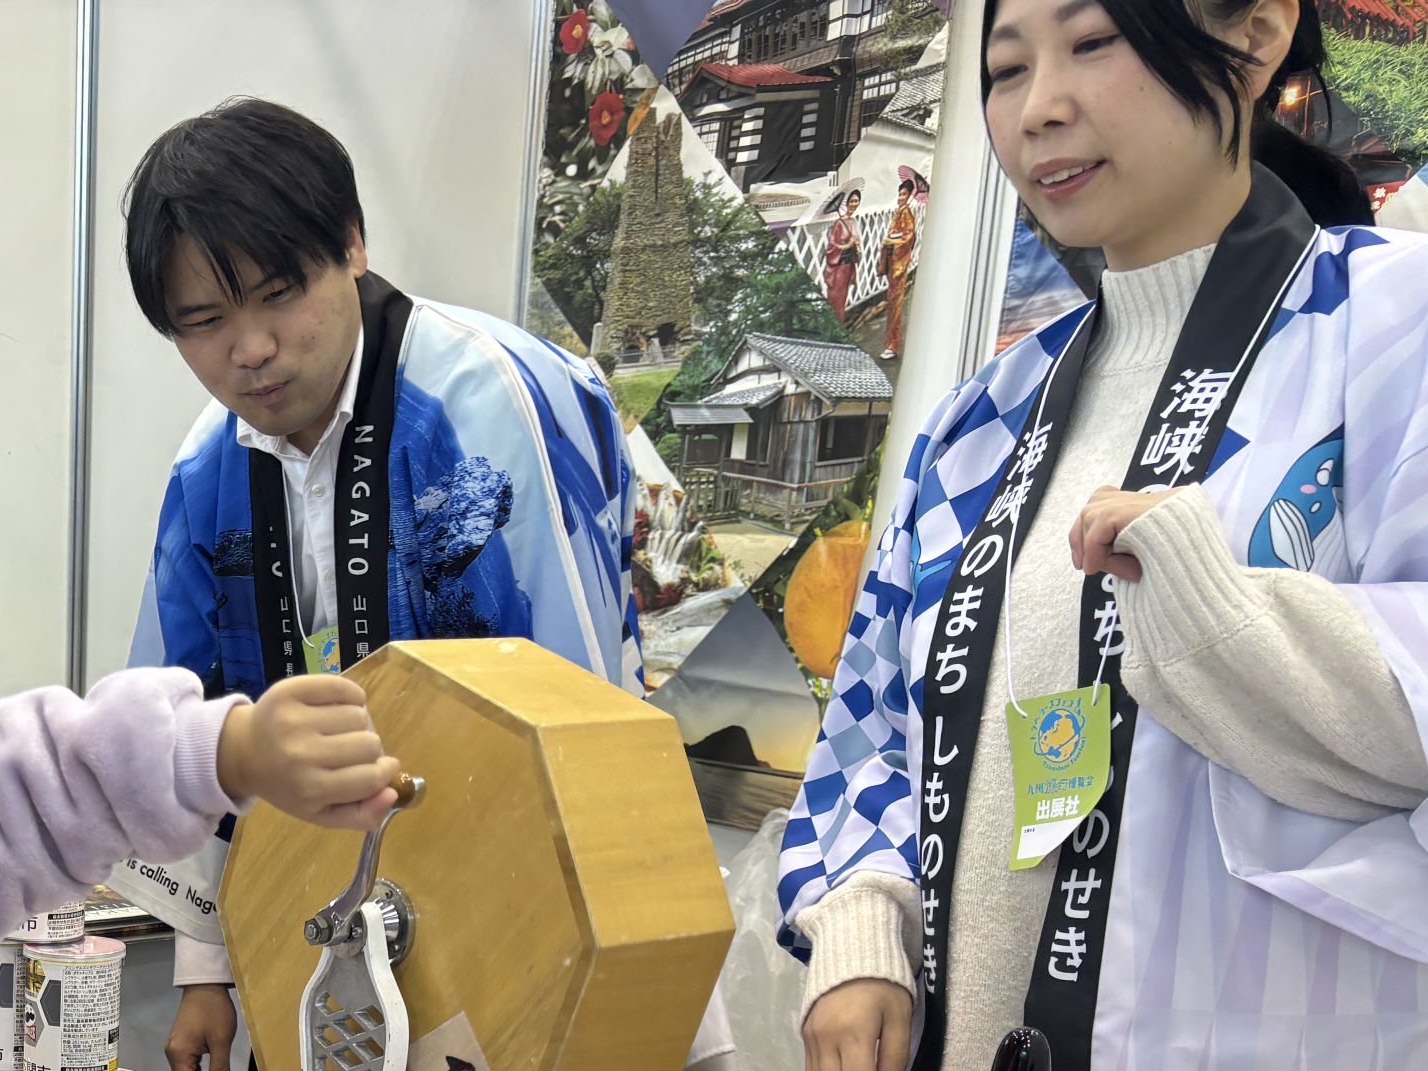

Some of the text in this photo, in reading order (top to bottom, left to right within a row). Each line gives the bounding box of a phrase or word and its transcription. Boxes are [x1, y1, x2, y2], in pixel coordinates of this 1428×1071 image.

[347, 424, 374, 576] NAGATO
[933, 421, 1053, 696] 海峡のまち
[1036, 794, 1080, 821] 出展社
[139, 864, 180, 896] calling
